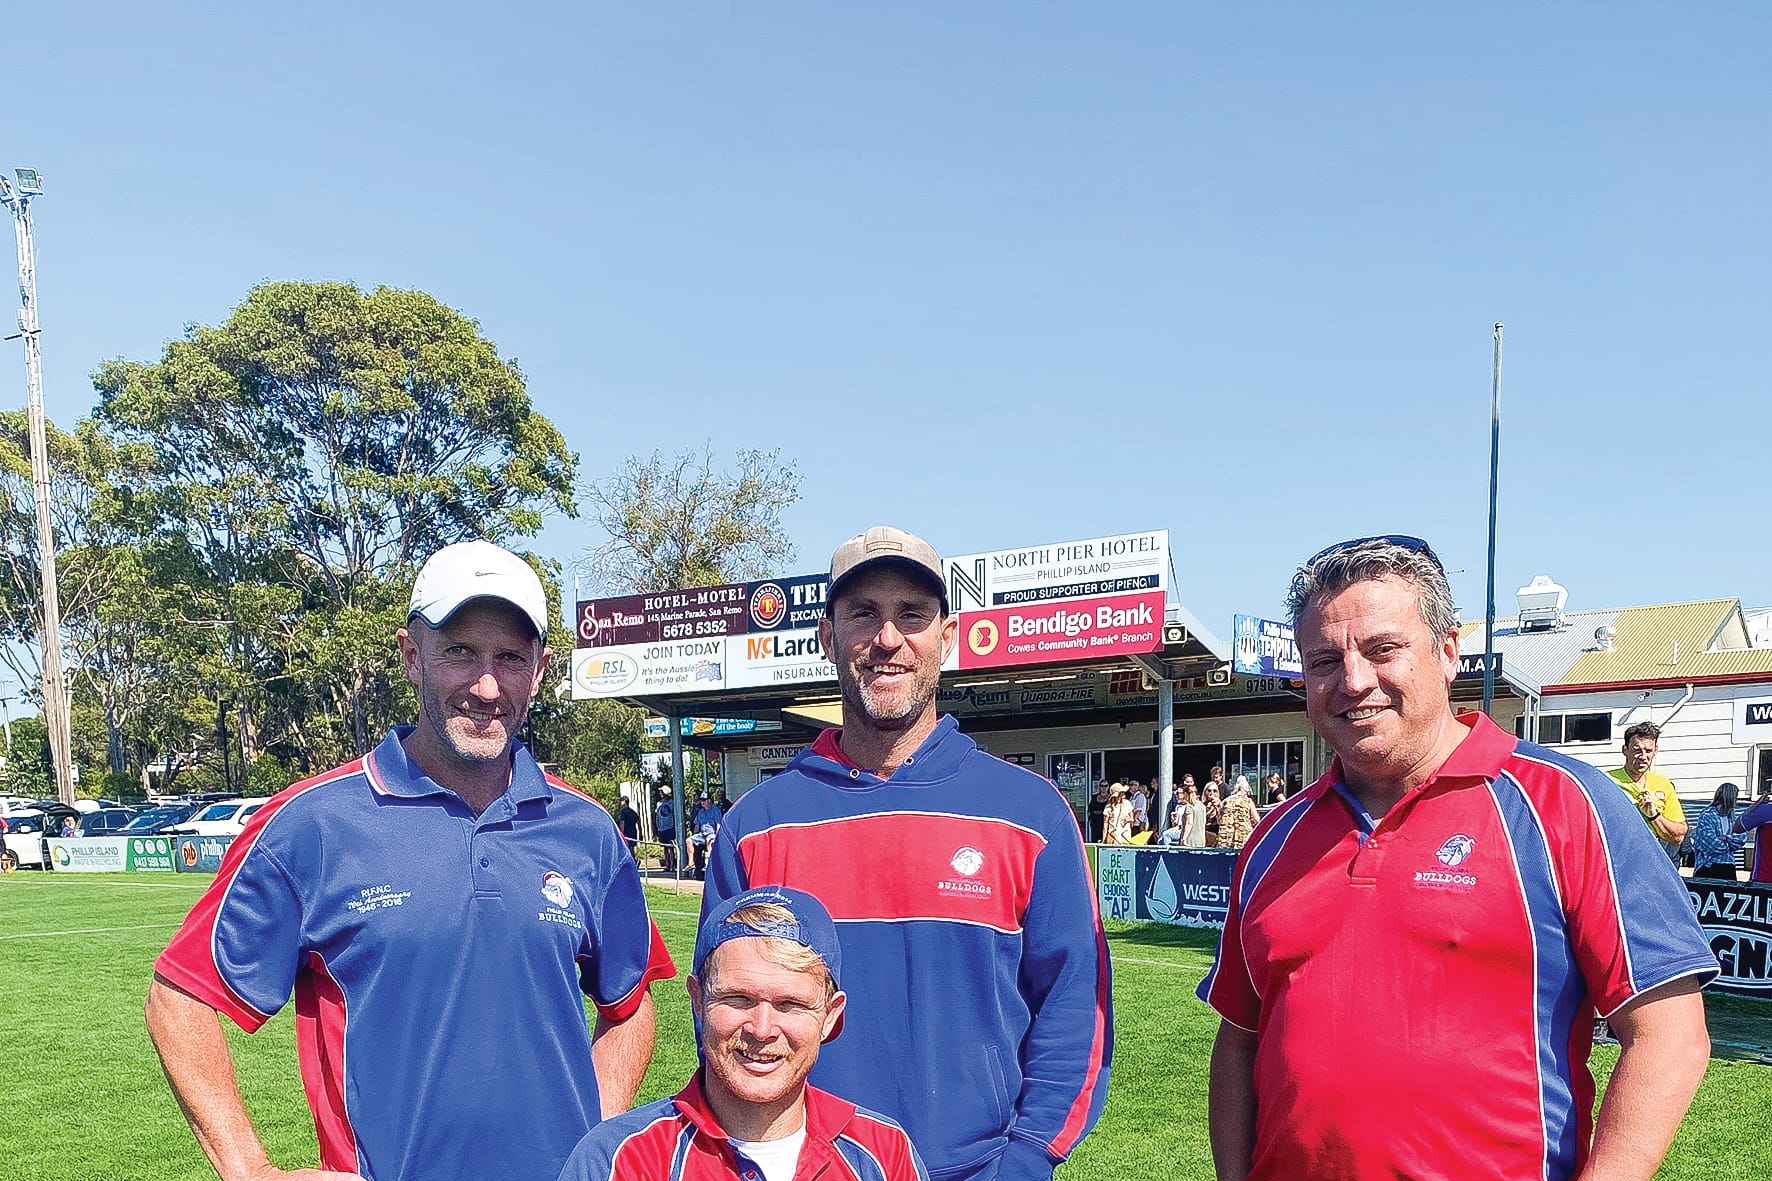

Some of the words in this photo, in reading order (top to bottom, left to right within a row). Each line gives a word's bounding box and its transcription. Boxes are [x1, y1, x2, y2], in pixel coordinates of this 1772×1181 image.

[993, 550, 1050, 569] NORTH
[1057, 544, 1094, 562] PIER
[1101, 536, 1160, 557] HOTEL
[1037, 567, 1072, 580] PHILLIP
[1074, 562, 1110, 576] ISLAND
[1003, 588, 1037, 603] PROUD
[1039, 582, 1098, 600] SUPPORTER
[1100, 580, 1114, 592] OF
[612, 612, 644, 627] Remo
[647, 613, 659, 622] 145
[661, 612, 683, 621] Marine
[685, 608, 707, 619] Parade,
[709, 607, 721, 616] San
[723, 606, 742, 615] Remo
[790, 609, 826, 622] EXCAV
[1008, 610, 1092, 637] Bendigo
[1096, 602, 1153, 629] Bank
[663, 622, 693, 638] 5678
[696, 619, 727, 635] 5352
[1008, 643, 1035, 654] Cowes
[1038, 638, 1088, 651] Community
[1121, 631, 1153, 643] Branch
[643, 645, 673, 660] JOIN
[677, 641, 720, 658] TODAY
[602, 660, 626, 674] RSL
[642, 667, 653, 676] It's
[655, 666, 668, 675] the
[669, 664, 695, 674] Aussie
[773, 665, 836, 680] INSURANCE
[645, 677, 664, 686] thing
[666, 676, 674, 684] to
[1246, 678, 1274, 692] 9796
[1021, 689, 1094, 703] QUADRA-FIRE
[1110, 854, 1122, 868] BE
[1102, 869, 1130, 884] SMART
[1414, 871, 1476, 885] BULLDOGS
[938, 881, 992, 894] BULLDOGS
[1103, 885, 1130, 897] CHOOSE
[538, 912, 582, 928] BULLDOGS
